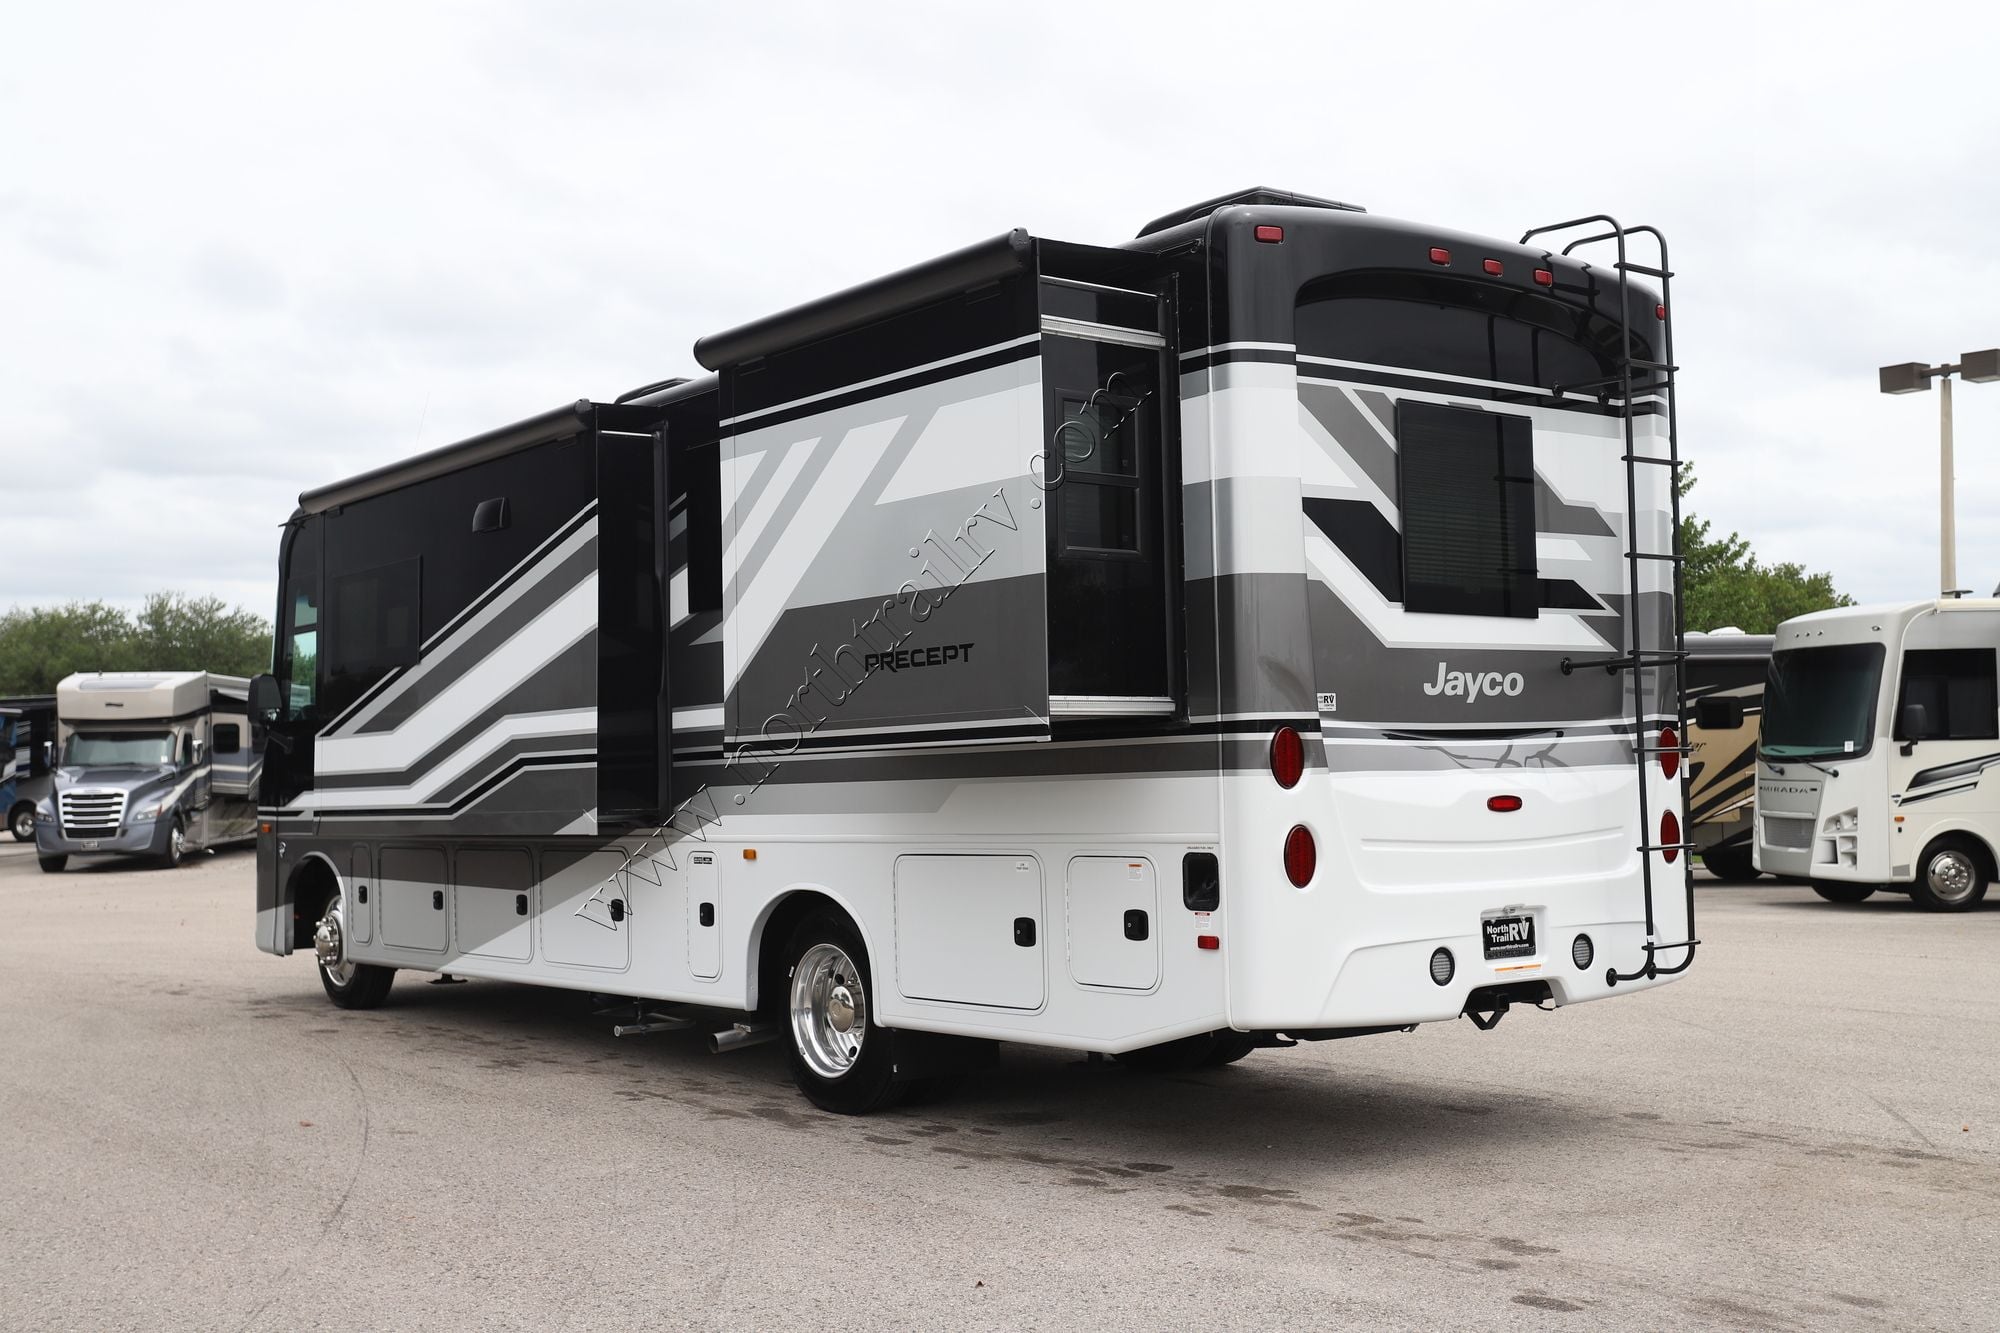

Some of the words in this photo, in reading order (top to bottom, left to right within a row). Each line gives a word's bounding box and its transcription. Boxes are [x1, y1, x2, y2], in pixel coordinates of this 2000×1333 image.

[864, 643, 975, 673] PRECEPT
[1423, 661, 1524, 704] Jayco
[1323, 694, 1335, 704] RV
[1486, 924, 1509, 934] North
[1508, 921, 1530, 941] RV
[1490, 933, 1510, 943] Trail
